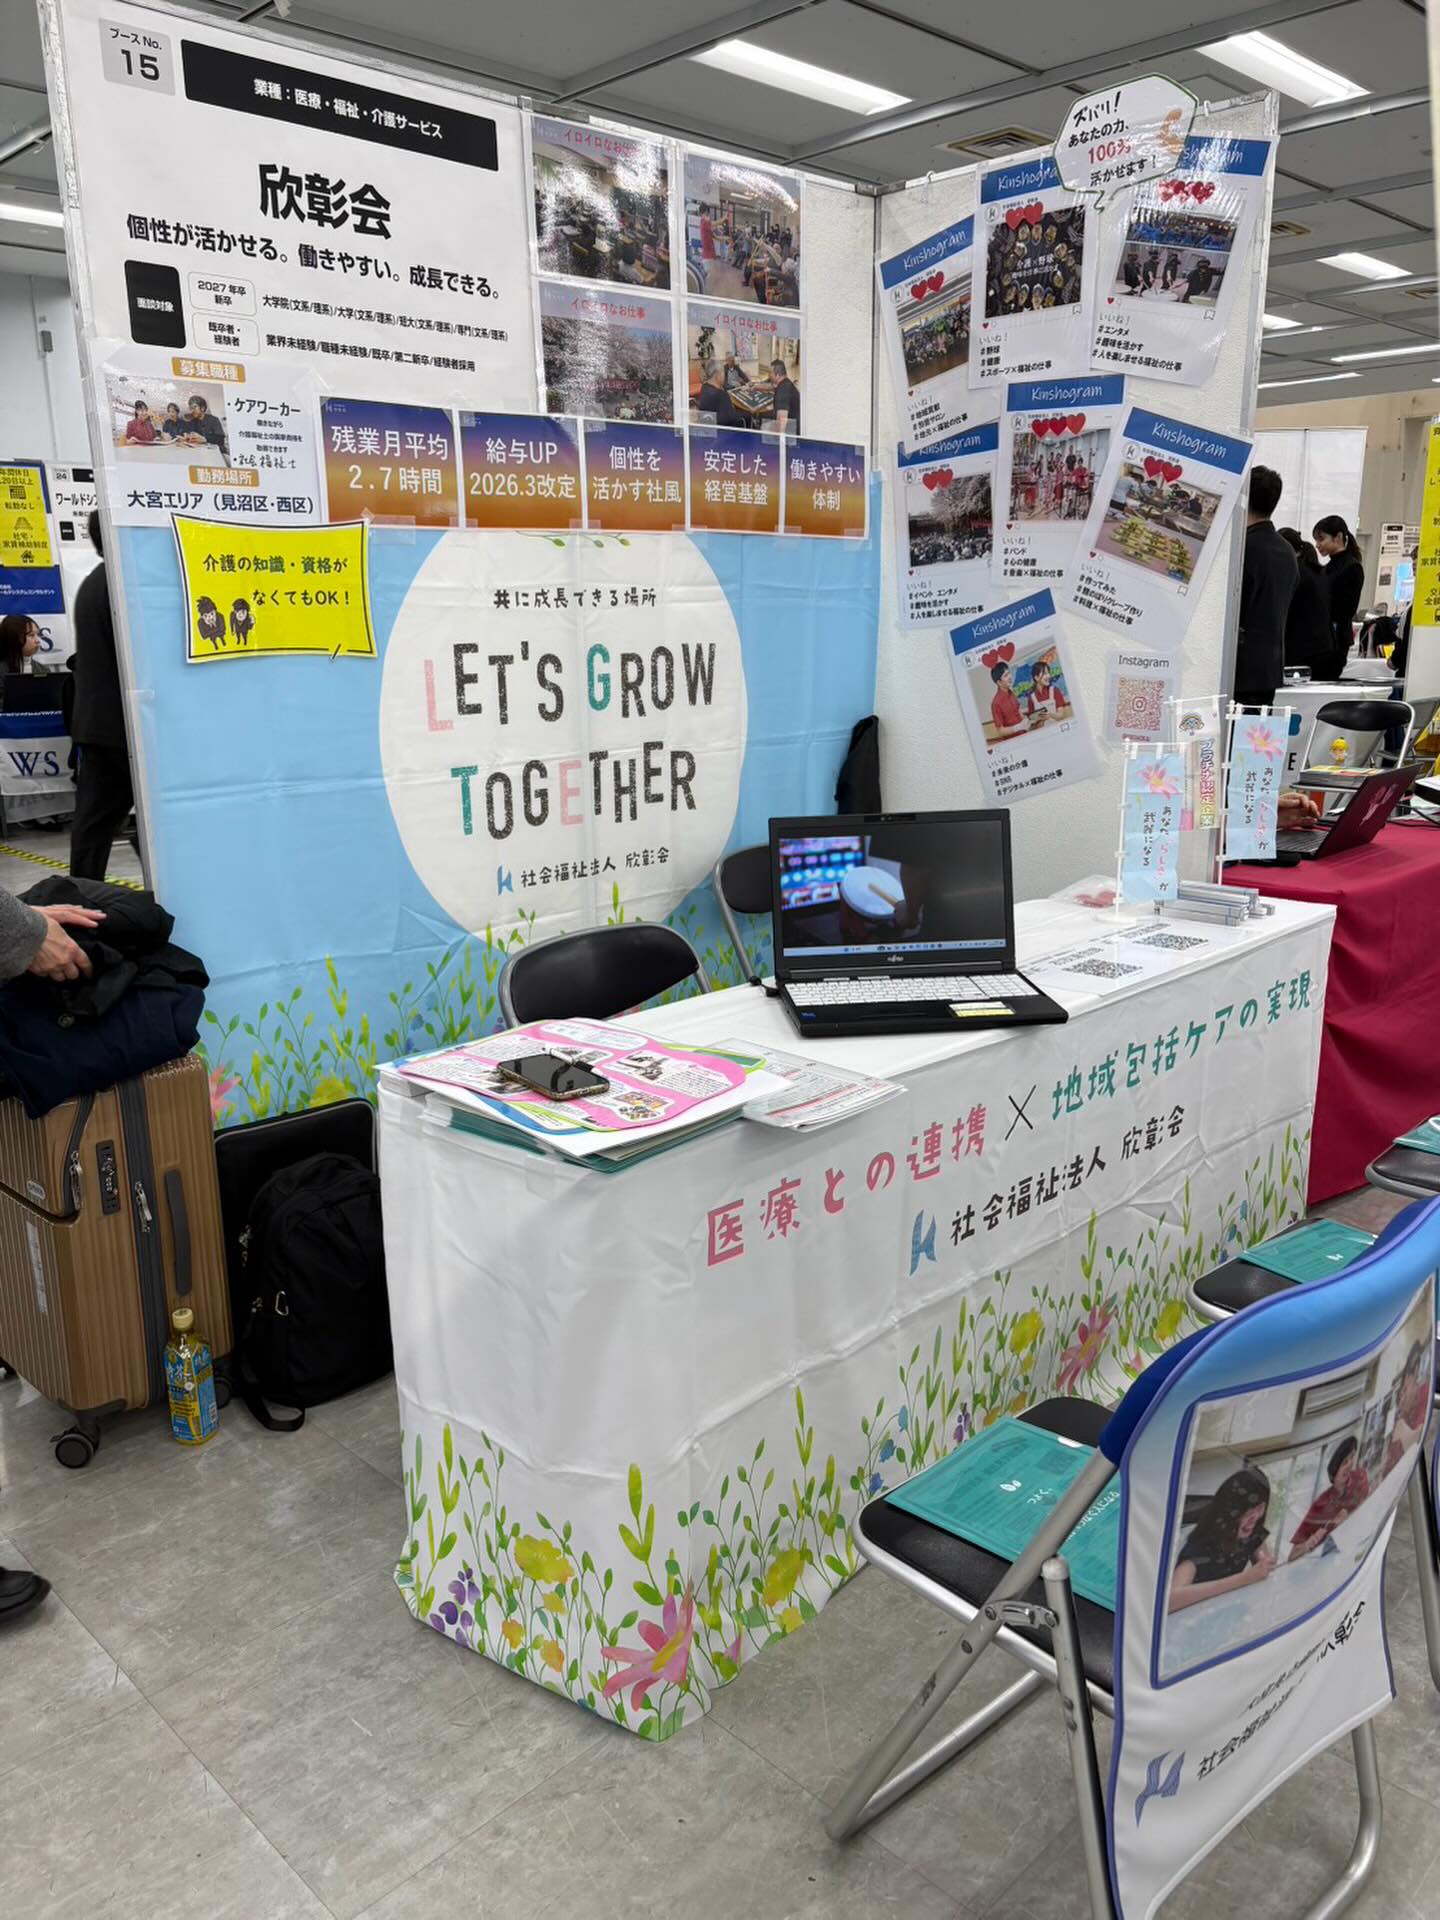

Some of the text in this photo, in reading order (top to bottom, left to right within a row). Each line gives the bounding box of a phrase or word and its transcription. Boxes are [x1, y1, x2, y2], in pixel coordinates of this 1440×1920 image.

[110, 28, 162, 50] ブース No.
[121, 49, 159, 81] 15
[254, 78, 443, 139] 業種：医療・福祉・介護サービス
[1073, 91, 1121, 128] ズバリ！
[564, 128, 641, 157] イロイロなお
[1068, 118, 1129, 148] あなたの力、
[1088, 138, 1132, 164] 100%
[998, 168, 1058, 191] Kinshogra
[1090, 155, 1156, 186] 活かせます！
[259, 163, 392, 239] 欣彰会
[903, 230, 966, 270] Kinshogram
[198, 280, 246, 296] 2027 年卒
[214, 295, 232, 306] 新卒
[571, 297, 645, 320] イロイロなお仕事
[714, 314, 778, 332] イロイロなお仕事
[214, 334, 240, 347] 経験者
[180, 359, 239, 381] 募集職種
[1031, 386, 1103, 405] Kinshogram
[331, 425, 448, 461] 残業月平均
[485, 437, 558, 464] 給与UP
[1151, 422, 1227, 459] Kinshogram
[609, 446, 661, 472] 個性を
[704, 449, 767, 476] 安定した
[790, 458, 861, 483] 働きやすい
[56, 472, 67, 480] 24
[196, 469, 251, 486] 勤務場所
[349, 465, 442, 495] 2.7時間
[470, 472, 576, 499] 2026.3改定
[593, 476, 682, 503] 活かす社風
[127, 489, 313, 514] 大宮エリア（見沼区・西区）
[704, 479, 768, 506] 経営基盤
[812, 489, 840, 512] 体制
[203, 554, 348, 573] 介護の知識・資格が
[252, 589, 350, 606] なくてもOK！
[493, 586, 657, 610] 共に成長できる場所
[972, 603, 1037, 639] Kinshogram
[1118, 655, 1170, 669] Instagram
[424, 640, 717, 732] LET'S GROW
[450, 740, 697, 841] TOGETHER
[521, 846, 670, 888] 社会福祉法人 欣彰会
[950, 1104, 1186, 1246] 社会福祉法人 欣彰会
